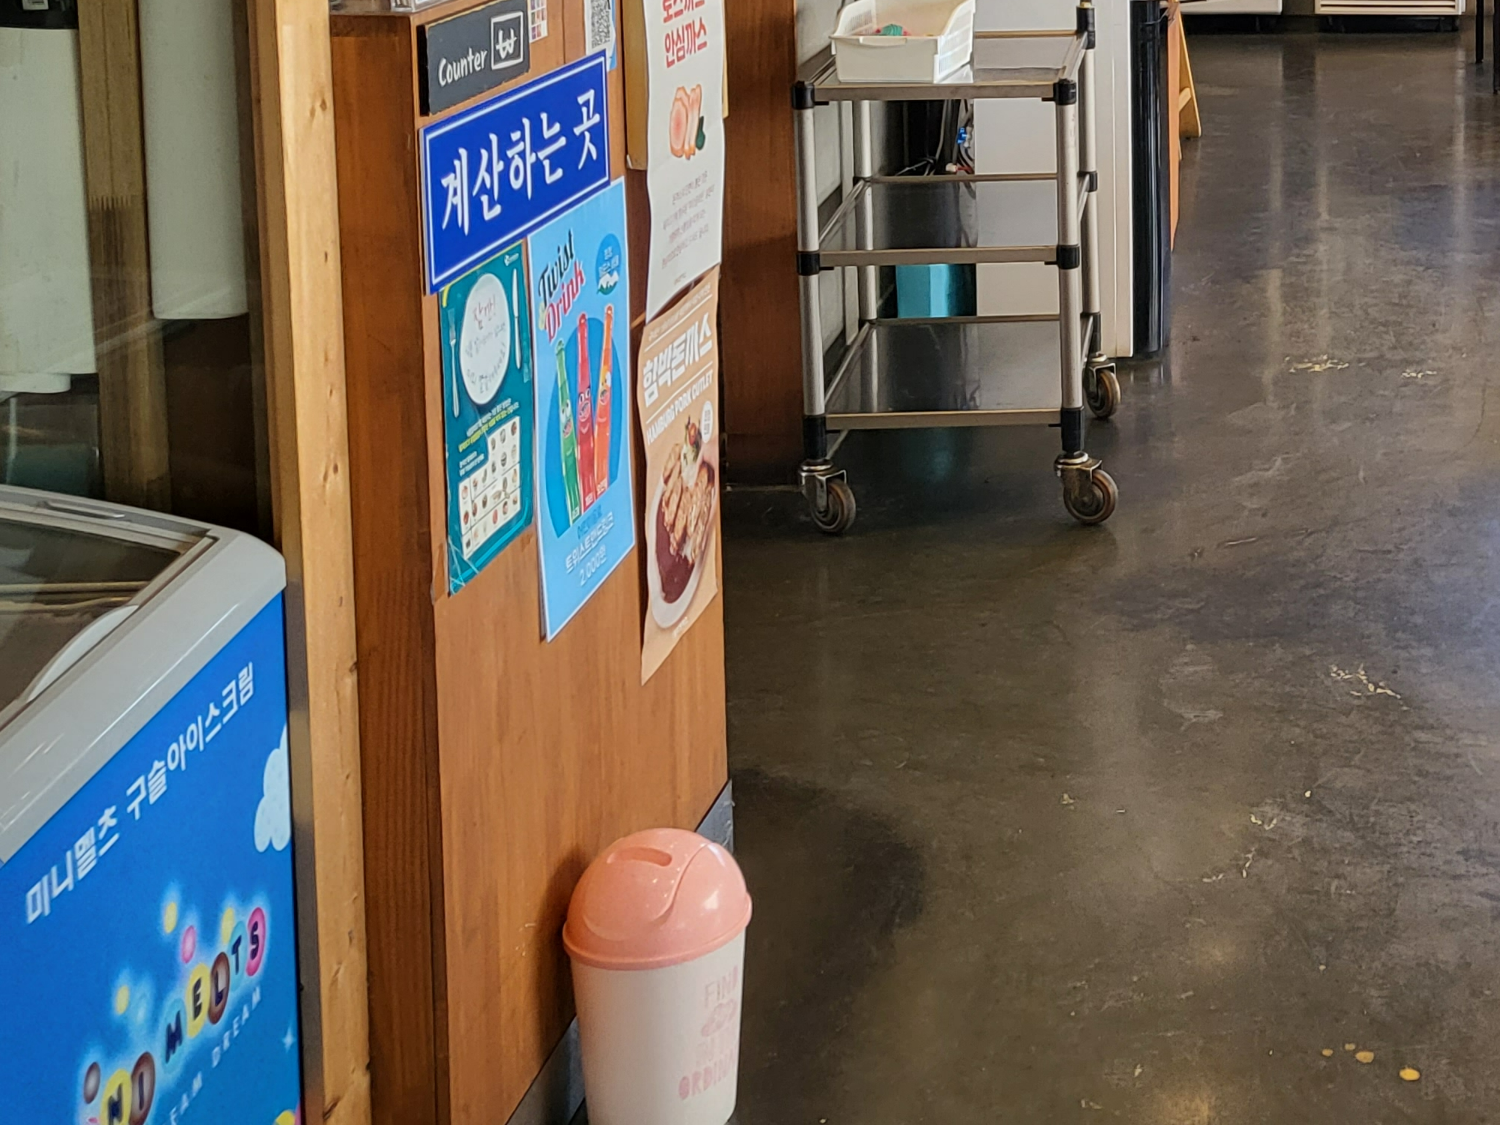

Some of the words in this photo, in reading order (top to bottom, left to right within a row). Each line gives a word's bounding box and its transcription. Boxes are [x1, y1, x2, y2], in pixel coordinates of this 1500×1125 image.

[438, 48, 487, 86] Counter
[664, 16, 707, 69] 안심까스
[440, 112, 567, 236] 계산하는
[573, 89, 600, 170] 곳
[538, 228, 573, 310] Twist
[545, 260, 584, 343] Drink
[642, 311, 713, 408] 함박돈까스
[25, 805, 119, 924] 미니멜츠
[126, 661, 254, 821] 구슬아이스크림
[165, 920, 259, 1064] MELTS
